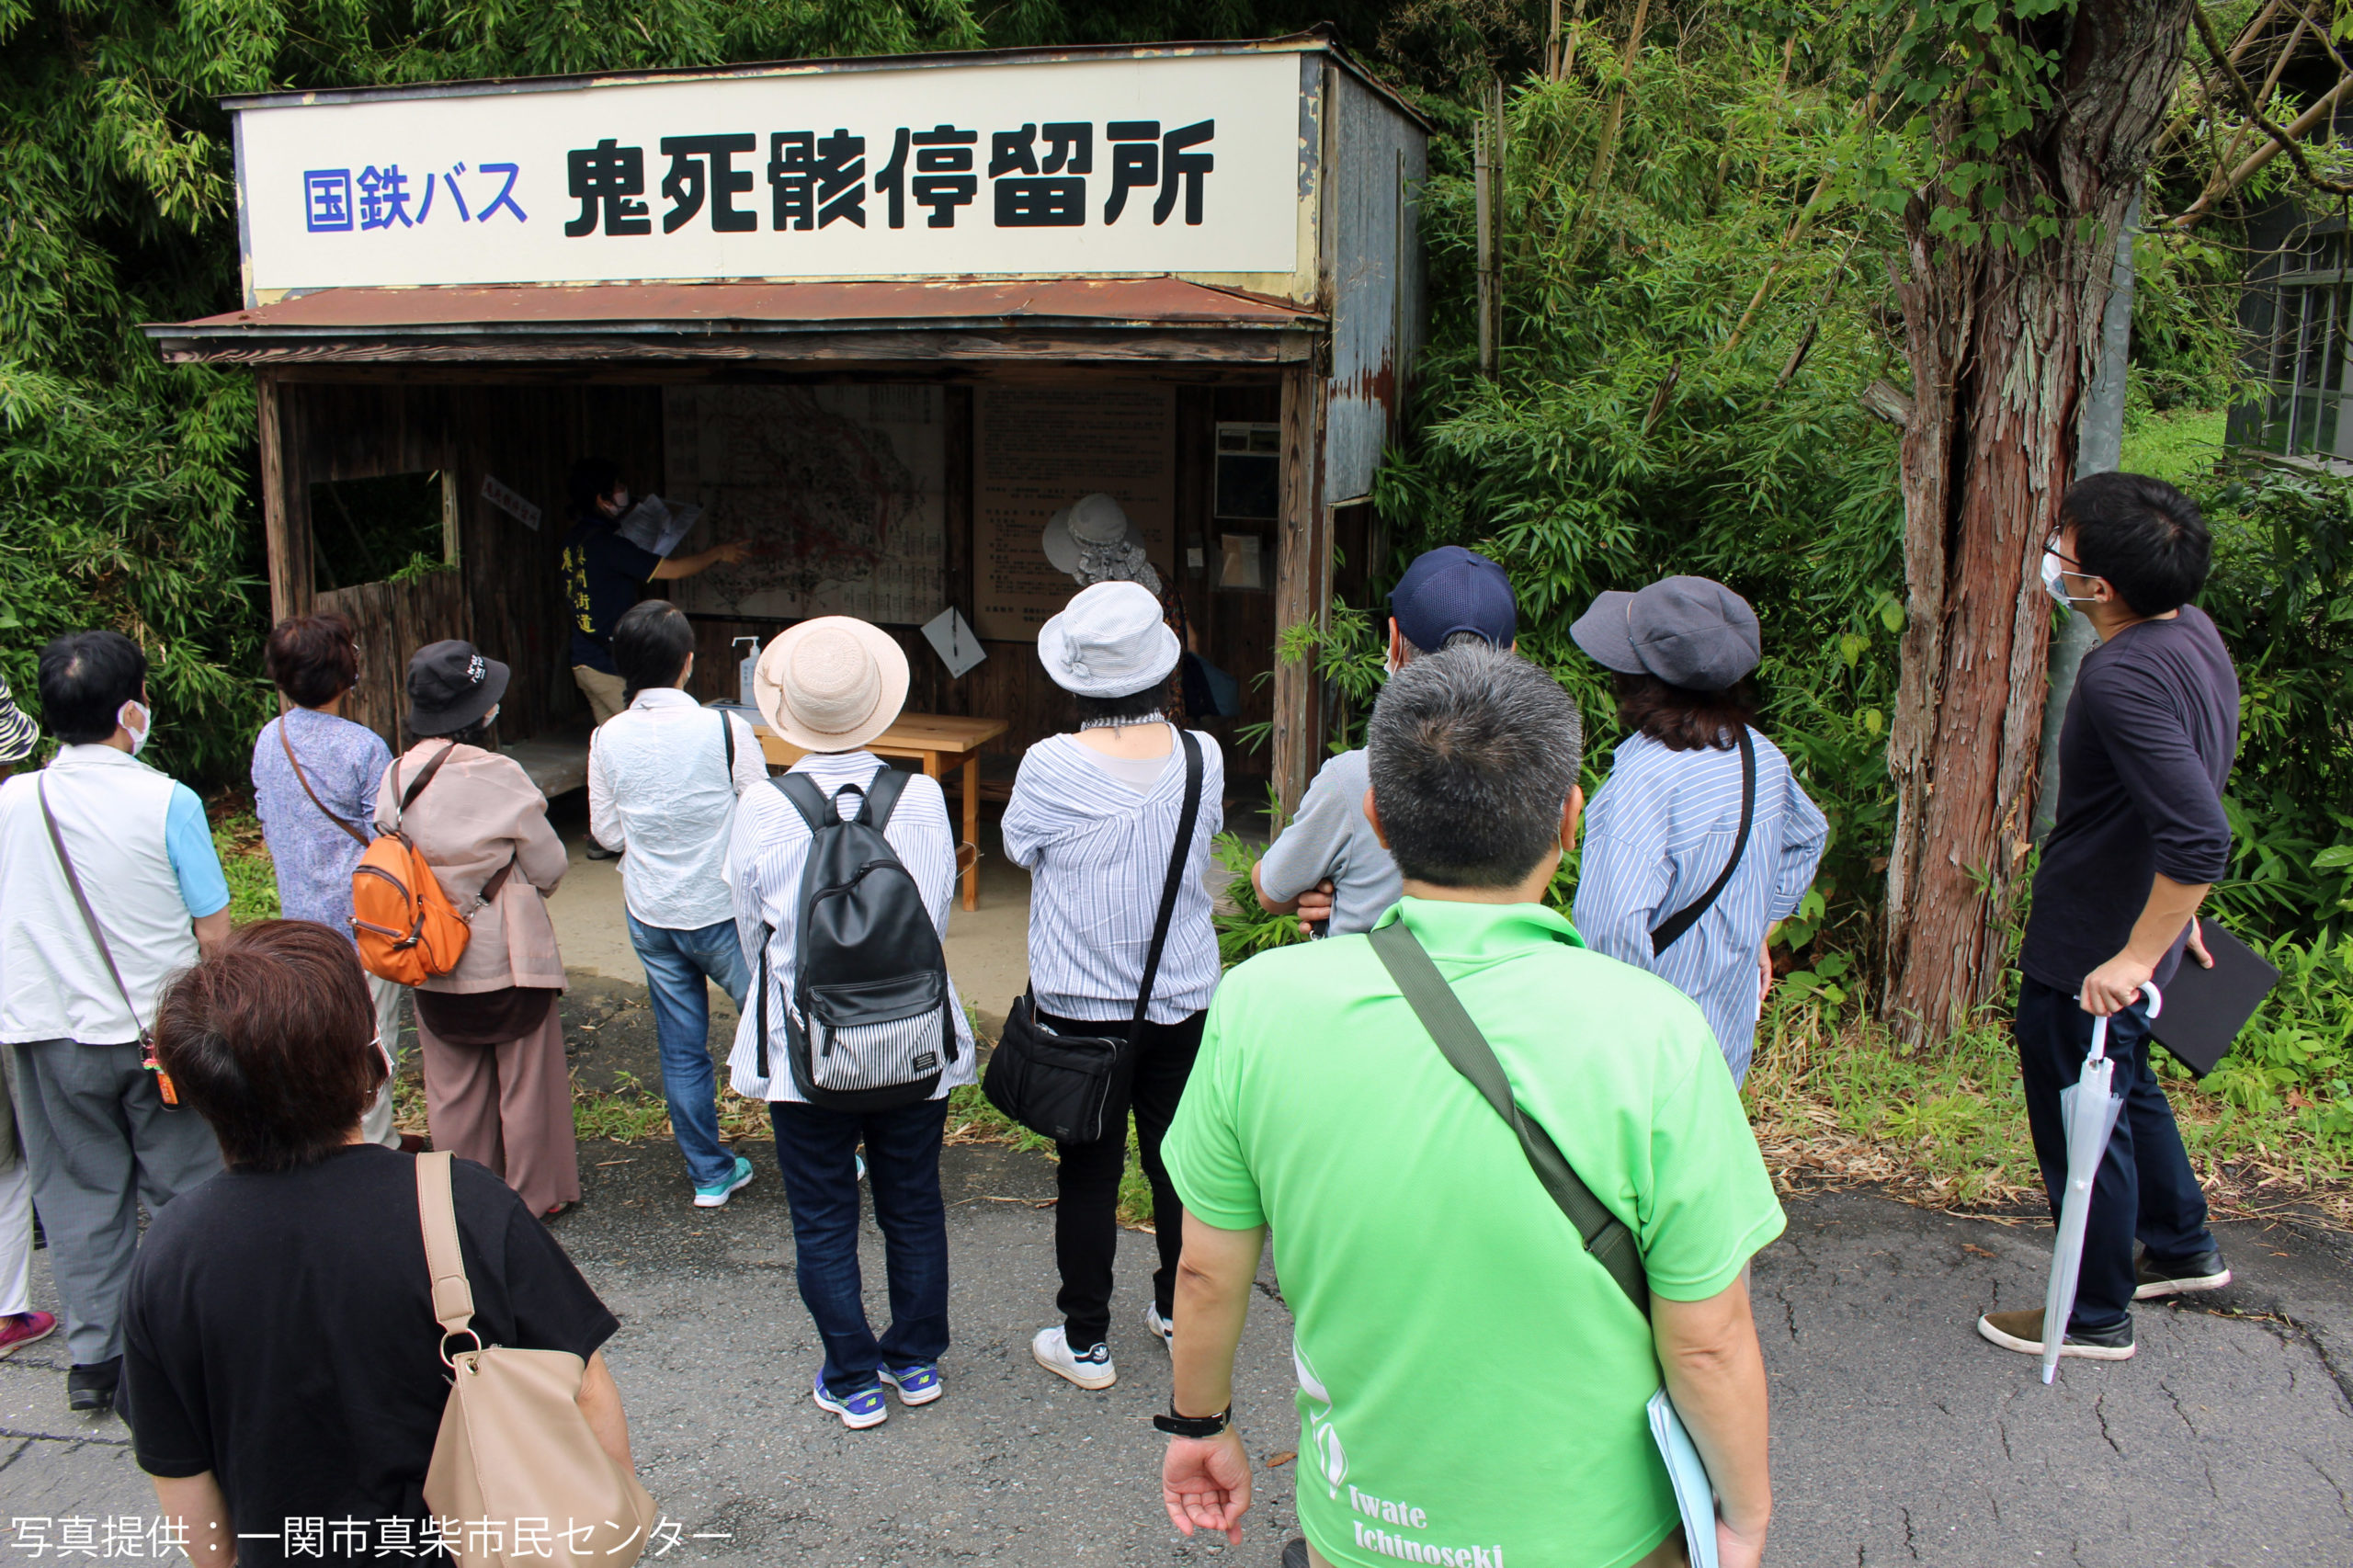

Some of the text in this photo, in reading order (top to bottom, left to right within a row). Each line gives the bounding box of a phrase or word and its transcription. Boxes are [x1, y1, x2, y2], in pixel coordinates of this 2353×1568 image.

[303, 161, 529, 233] 国鉄バス
[563, 119, 1215, 238] 鬼死骸停留所
[1348, 1483, 1427, 1529] Iwate
[1353, 1519, 1505, 1568] Ichinoseki
